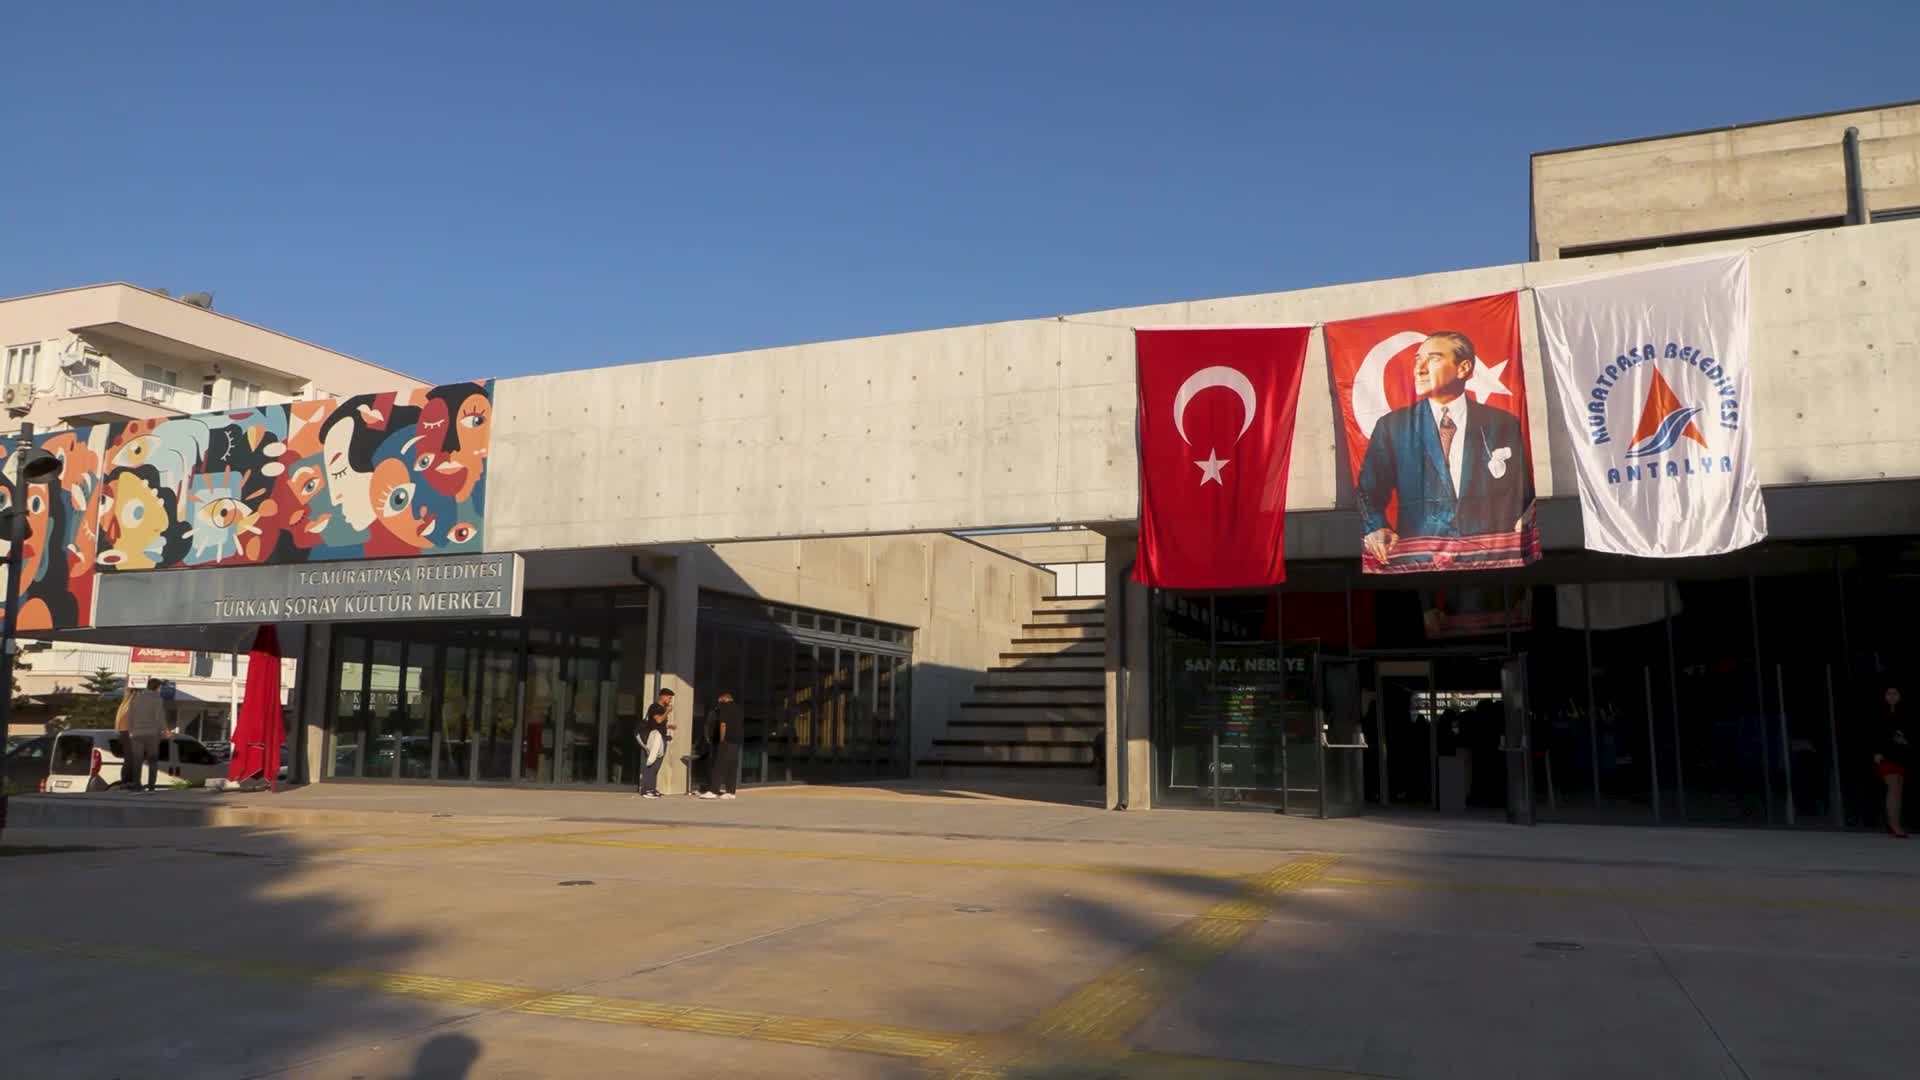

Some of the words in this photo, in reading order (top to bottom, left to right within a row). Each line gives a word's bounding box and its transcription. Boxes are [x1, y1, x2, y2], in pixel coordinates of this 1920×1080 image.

[1608, 455, 1732, 484] ANTALYA
[416, 558, 504, 581] BELEDİYESİ
[214, 594, 280, 617] TÜRKAN
[284, 596, 339, 619] ŞORAY
[344, 590, 412, 613] KÜLTÜR
[418, 586, 502, 611] MERKEZİ
[1245, 657, 1305, 672] NERYE
